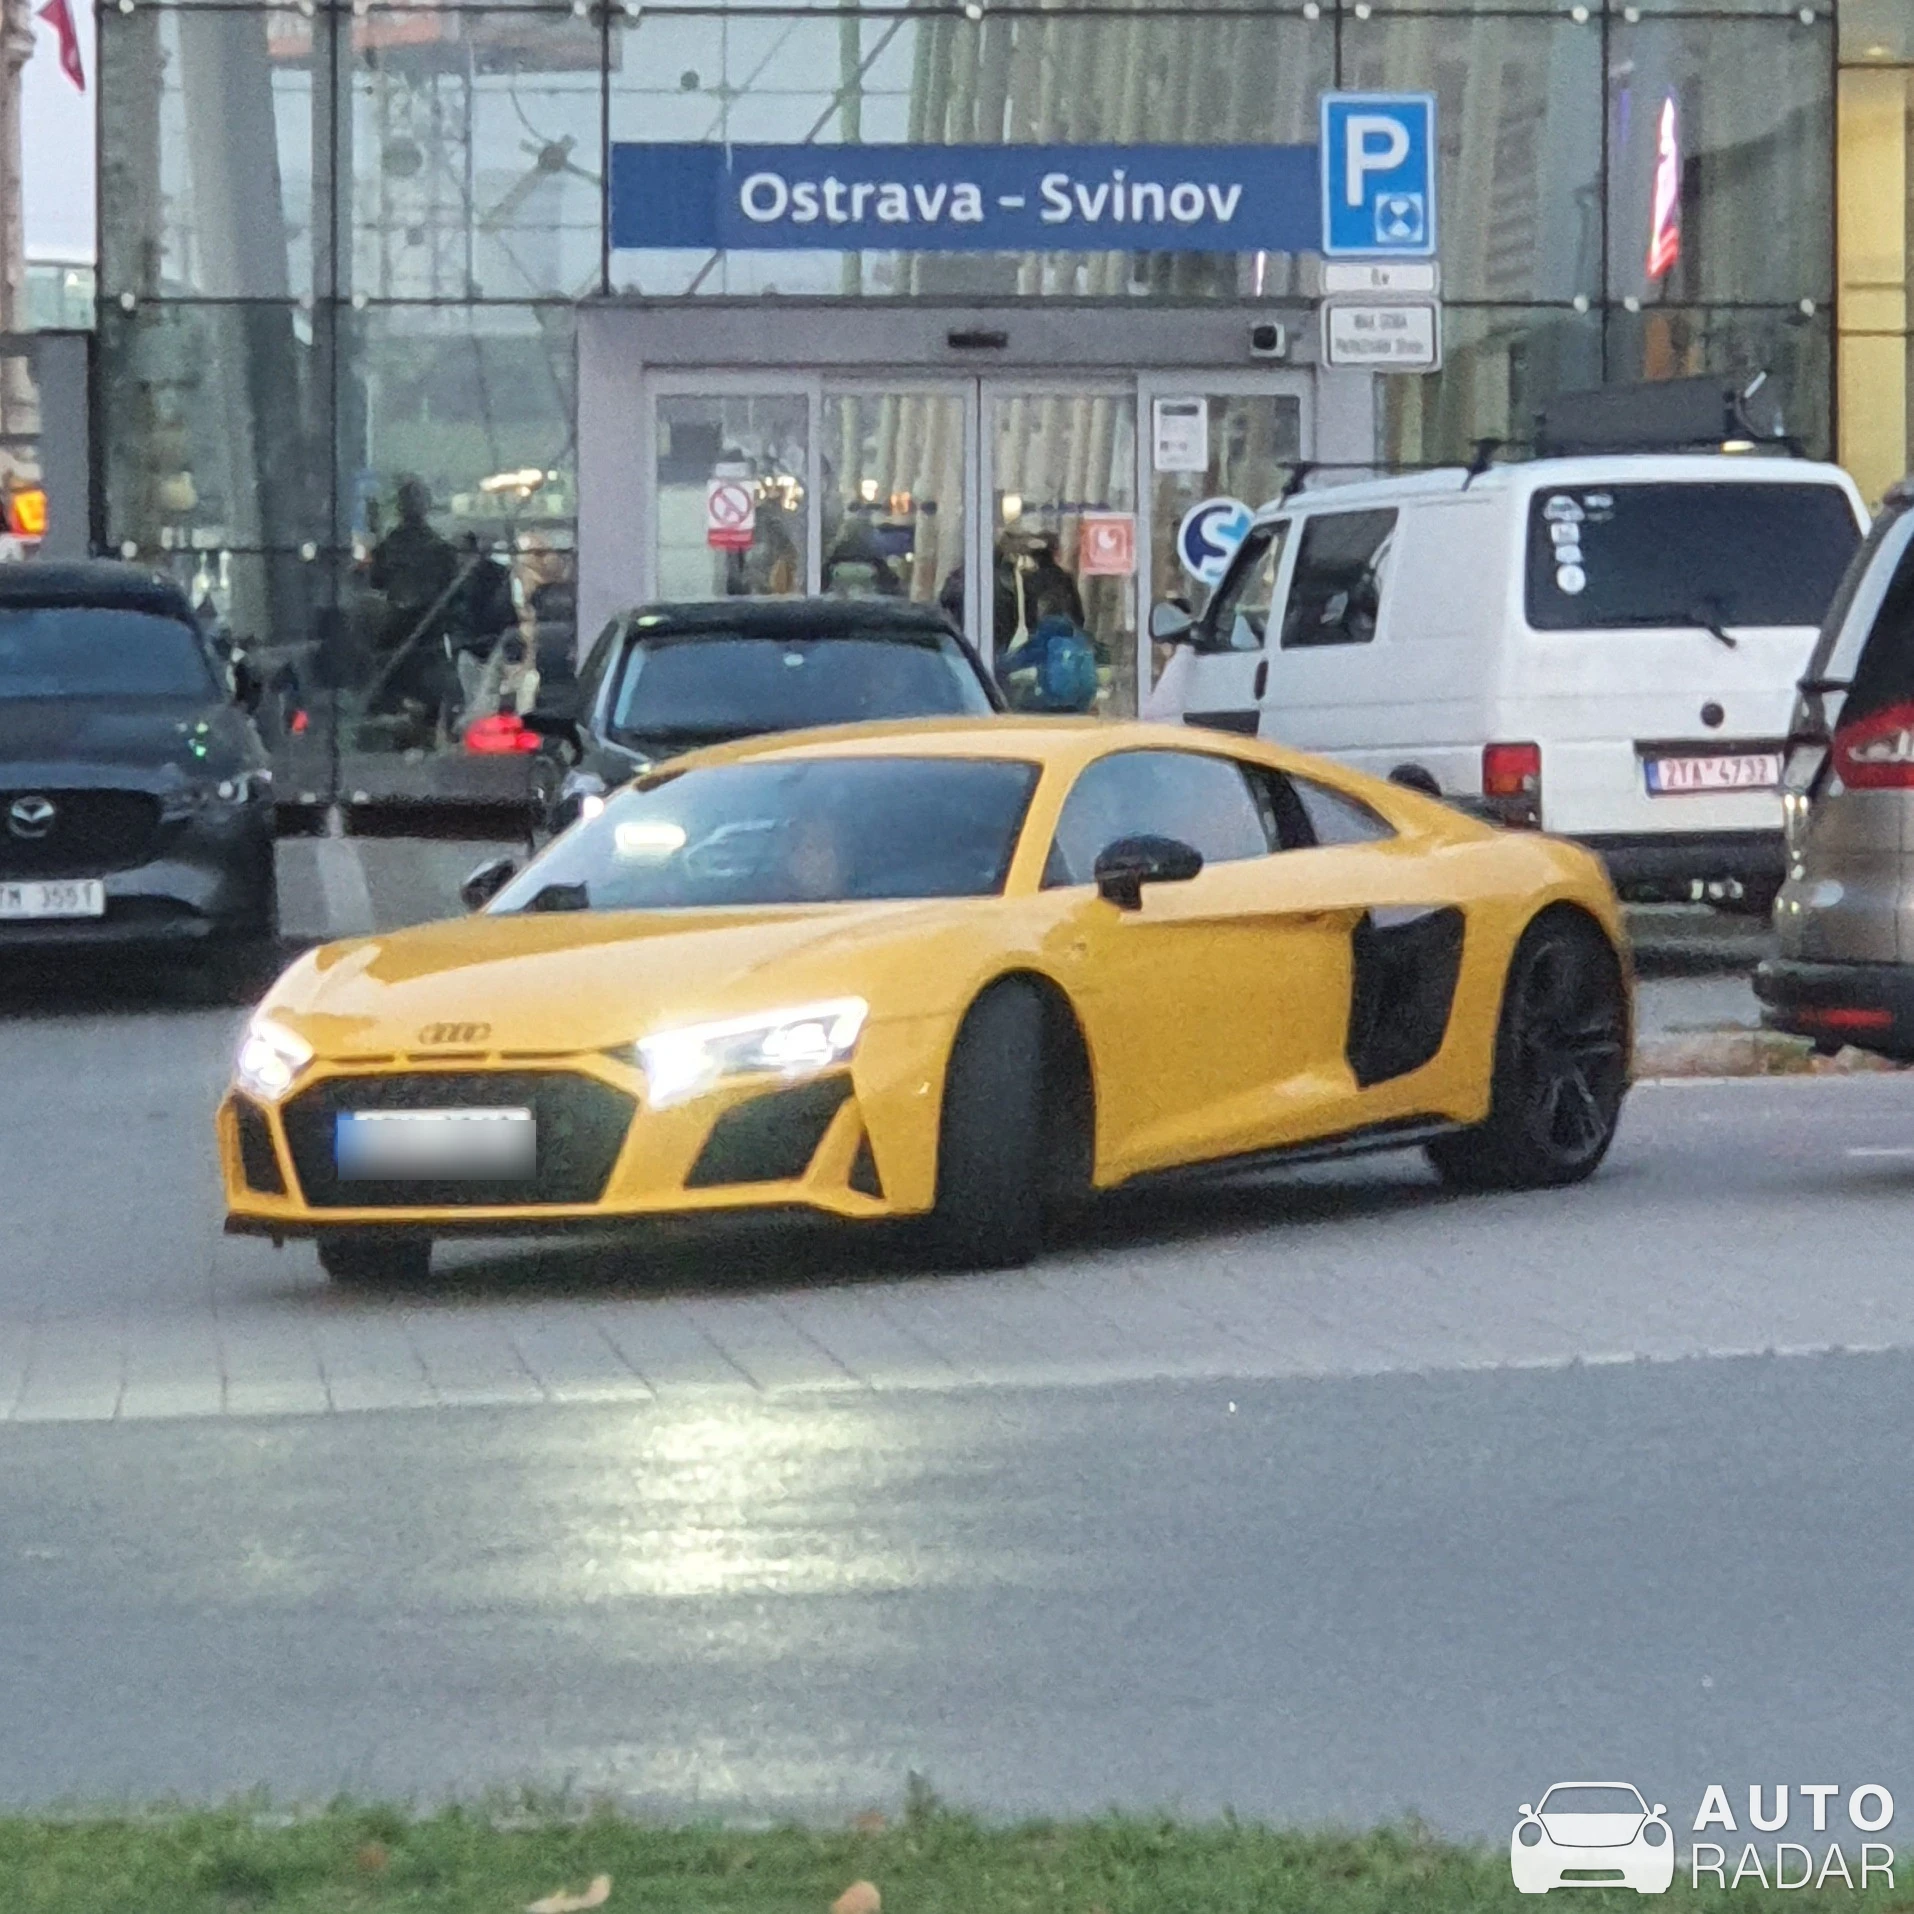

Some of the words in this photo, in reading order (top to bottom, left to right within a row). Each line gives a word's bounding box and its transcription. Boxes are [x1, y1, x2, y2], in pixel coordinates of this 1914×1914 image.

[740, 172, 984, 222] Ostrava
[1039, 168, 1243, 222] Svinov
[1346, 115, 1410, 206] P
